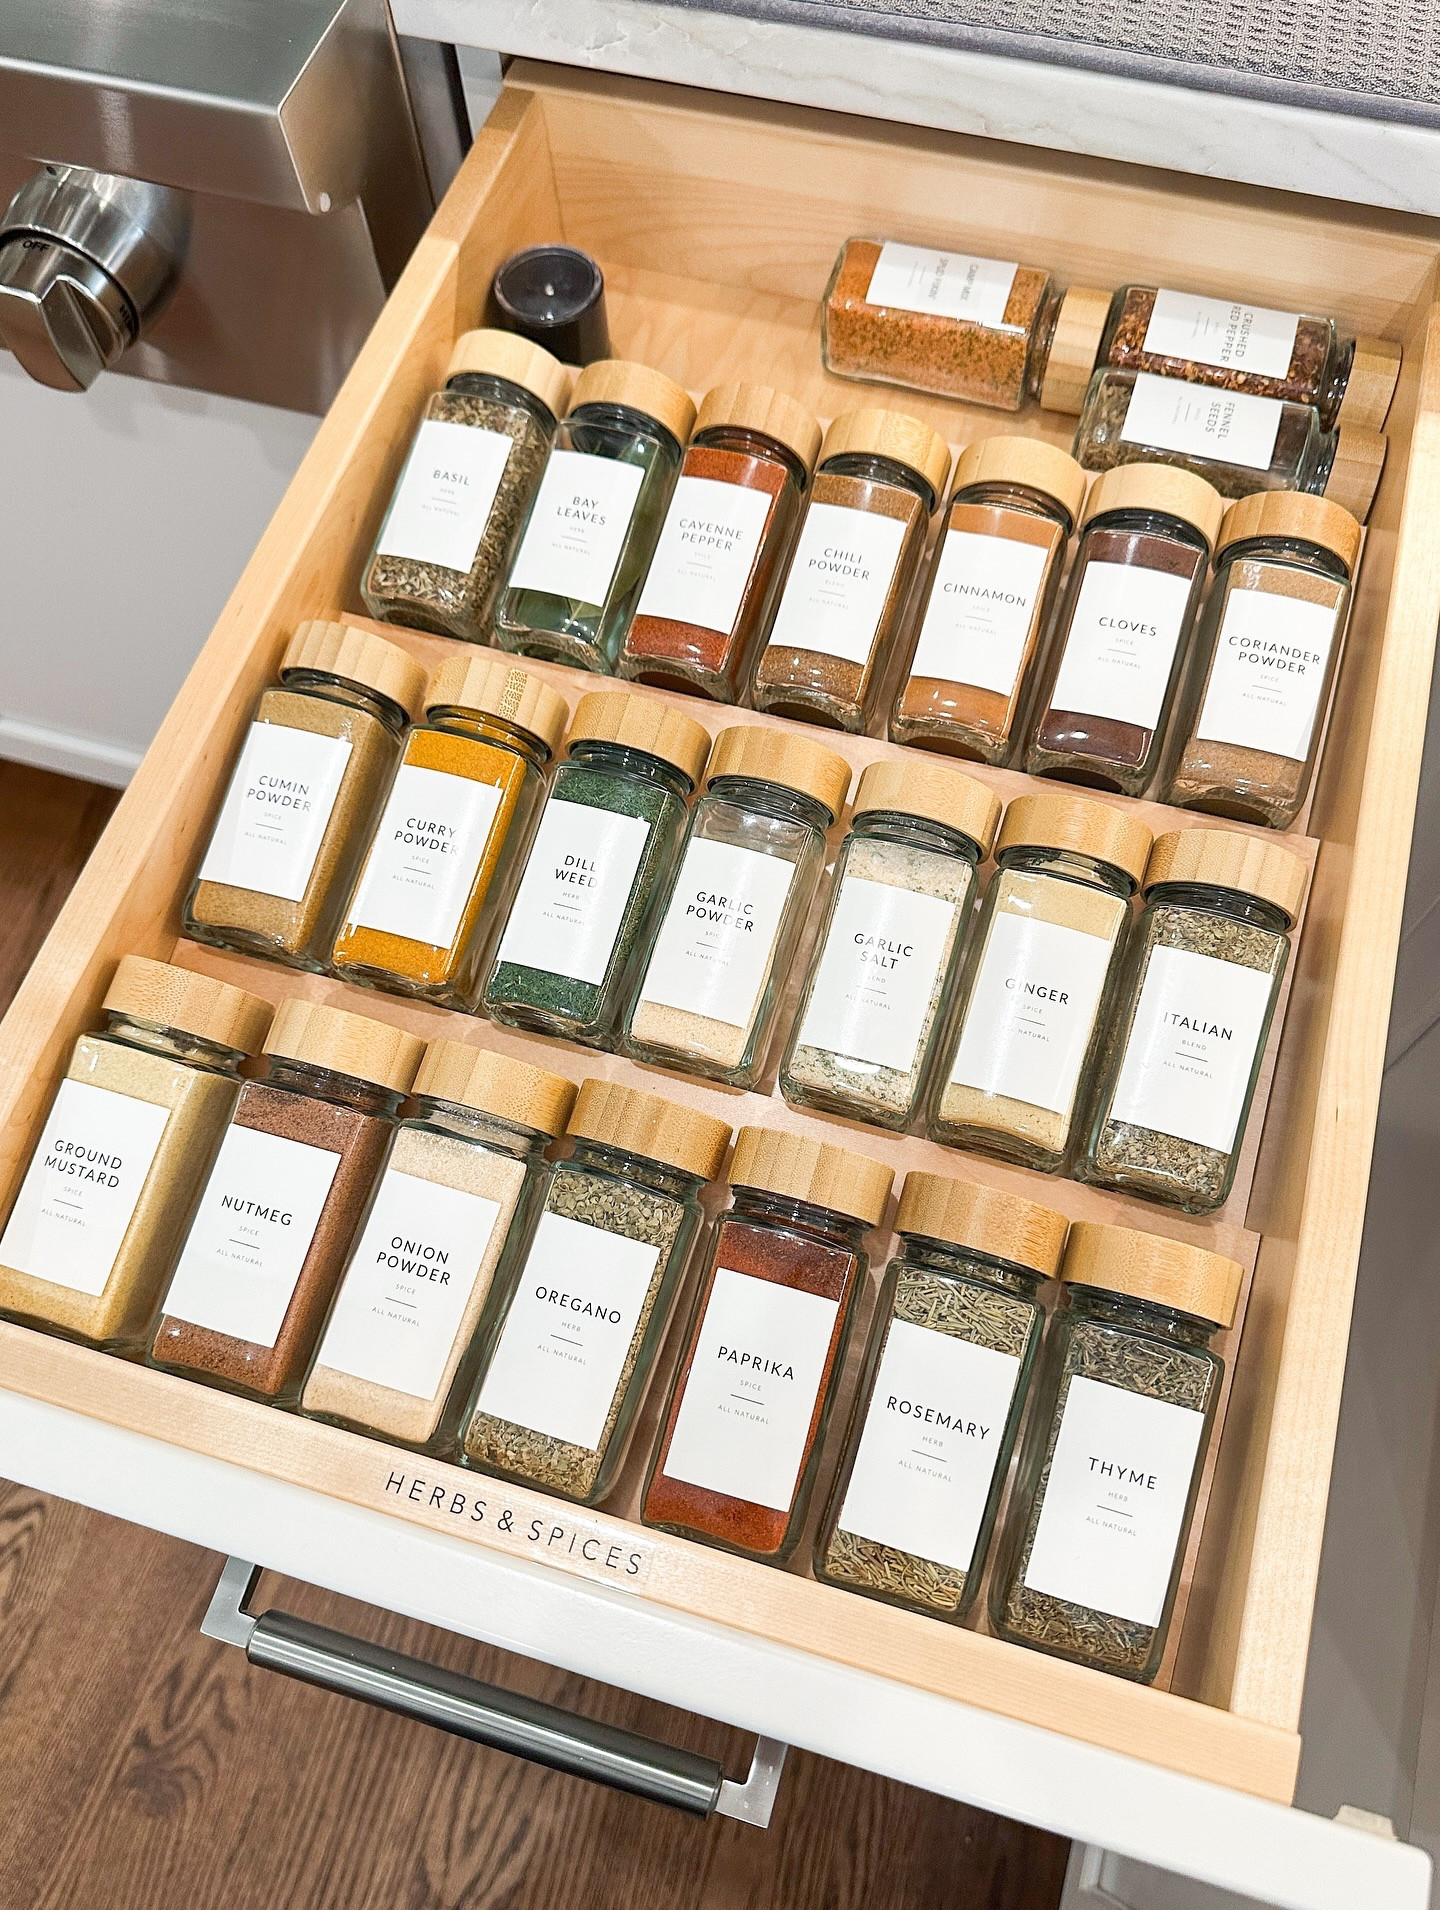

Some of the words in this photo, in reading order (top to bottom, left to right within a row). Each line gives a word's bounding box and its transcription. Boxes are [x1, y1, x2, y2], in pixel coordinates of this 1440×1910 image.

[23, 241, 50, 250] OFF
[1230, 305, 1242, 321] RED
[1220, 323, 1238, 362] PEPPER
[1235, 312, 1254, 358] CRUSHED
[1205, 401, 1221, 434] SEEDS
[1217, 402, 1235, 439] FENNEL
[433, 470, 470, 486] BASIL
[572, 496, 600, 508] BAY
[557, 507, 606, 526] LEAVES
[679, 518, 744, 541] CAYENNE
[565, 545, 591, 556] NATURAL
[681, 532, 733, 551] PEPPER
[823, 548, 863, 564] CHILI
[808, 559, 870, 581] POWDER
[943, 583, 1027, 607] CINNAMON
[970, 626, 997, 636] NATURAL
[1099, 616, 1157, 637] CLOVES
[1228, 636, 1321, 665] CORIANDER
[1113, 659, 1141, 670] NATURAL
[1238, 651, 1306, 675] POWDER
[1257, 695, 1287, 707] NATURAL
[259, 775, 310, 796] CUMIN
[247, 788, 312, 812] POWDER
[263, 812, 282, 821] SPICE
[406, 817, 457, 839] CURRY
[259, 835, 287, 846] NATURAL
[411, 855, 430, 864] SPICE
[564, 855, 597, 873] DILL
[392, 874, 404, 882] ALL
[406, 878, 435, 890] NATURAL
[555, 869, 597, 889] WEED
[562, 892, 580, 900] HERB
[696, 891, 754, 916] GARLIC
[542, 911, 554, 919] ALL
[686, 904, 754, 932] POWDER
[705, 931, 720, 939] SPIC
[685, 950, 697, 958] ALL
[854, 933, 913, 957] GARLIC
[859, 951, 898, 970] SALT
[1022, 1004, 1042, 1014] SPICE
[1018, 1029, 1050, 1042] NATURAL
[1163, 1012, 1233, 1041] ITALIAN
[1181, 1040, 1206, 1051] BLEND
[1163, 1060, 1178, 1069] ALL
[1179, 1064, 1213, 1079] NATURAL
[54, 1140, 122, 1170] GROUND
[44, 1155, 119, 1188] MUSTARD
[63, 1186, 83, 1196] SPICE
[41, 1208, 55, 1216] ALL
[56, 1212, 87, 1227] NATURAL
[221, 1195, 293, 1226] NUTMEG
[239, 1226, 259, 1236] SPICE
[216, 1248, 231, 1258] ALL
[232, 1253, 264, 1267] NATURAL
[391, 1236, 450, 1265] ONION
[376, 1251, 451, 1286] POWDER
[395, 1284, 416, 1294] SPICE
[535, 1286, 621, 1324] OREGANO
[371, 1306, 387, 1315] ALL
[388, 1311, 420, 1327] NATURAL
[561, 1322, 581, 1332] HERB
[537, 1344, 552, 1354] ALL
[553, 1349, 587, 1365] NATURAL
[717, 1346, 794, 1380] PAPRIKA
[740, 1380, 761, 1391] SPICE
[718, 1404, 733, 1413] ALL
[734, 1409, 769, 1424] NATURAL
[886, 1395, 990, 1440] ROSEMARY
[922, 1436, 944, 1448] HERB
[898, 1460, 914, 1469] ALL
[915, 1465, 952, 1482] NATURAL
[1089, 1456, 1157, 1490] THYME
[1108, 1491, 1128, 1502] HERB
[385, 1471, 487, 1522] HERBS
[497, 1510, 515, 1533] &
[527, 1519, 642, 1575] SPICES
[1086, 1516, 1101, 1525] ALL
[1102, 1521, 1136, 1536] NATURAL
